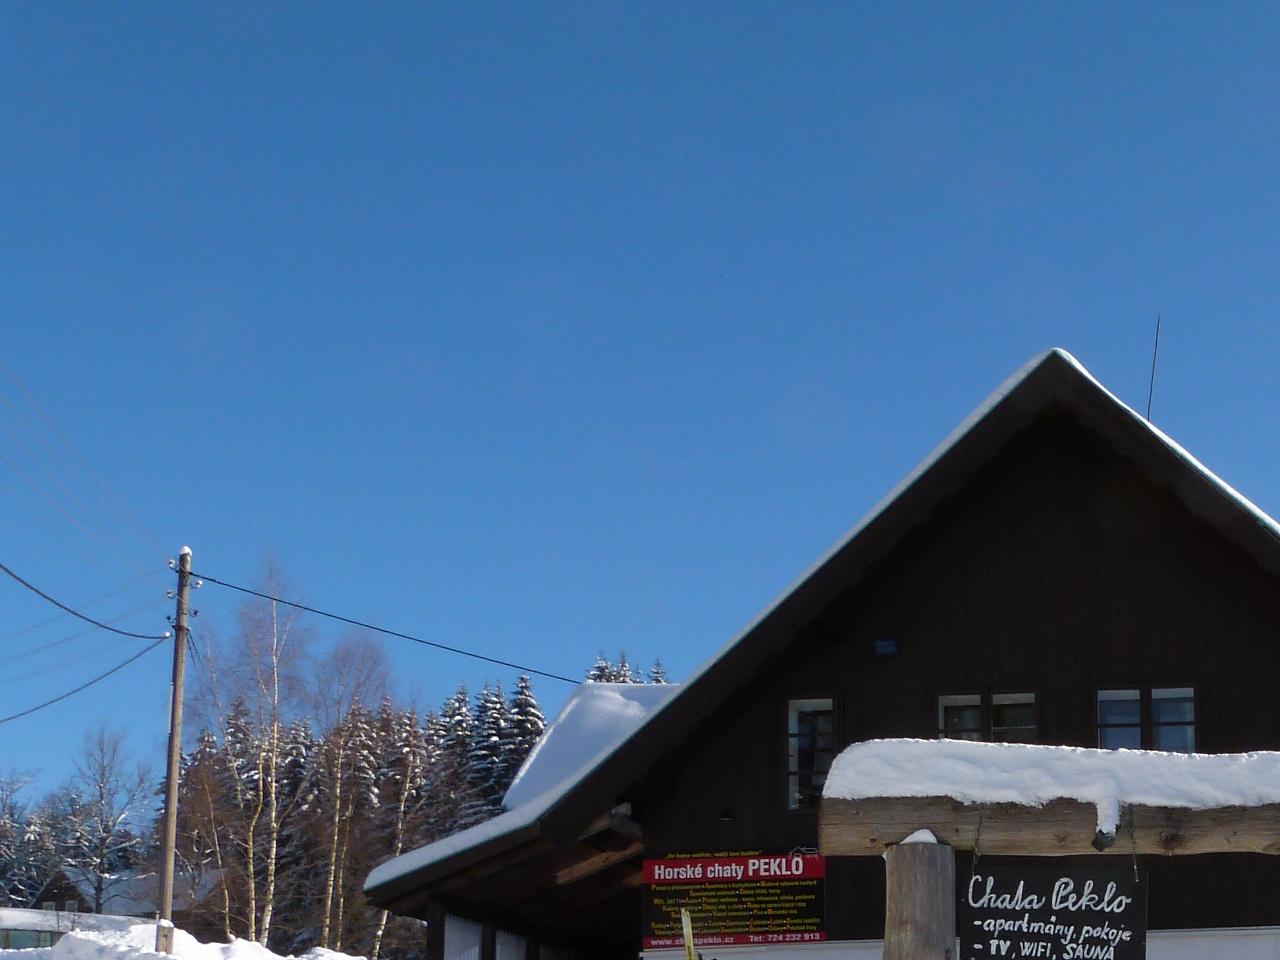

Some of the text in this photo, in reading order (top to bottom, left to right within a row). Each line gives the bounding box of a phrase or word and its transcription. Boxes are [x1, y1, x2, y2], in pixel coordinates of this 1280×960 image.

[654, 857, 804, 881] Horské chaty PEKLO
[1051, 877, 1133, 913] Peklo
[767, 934, 783, 942] 724
[785, 933, 801, 941] 232
[803, 932, 820, 940] 913
[1080, 921, 1133, 947] pokoje
[1062, 943, 1115, 960] SAUNA
